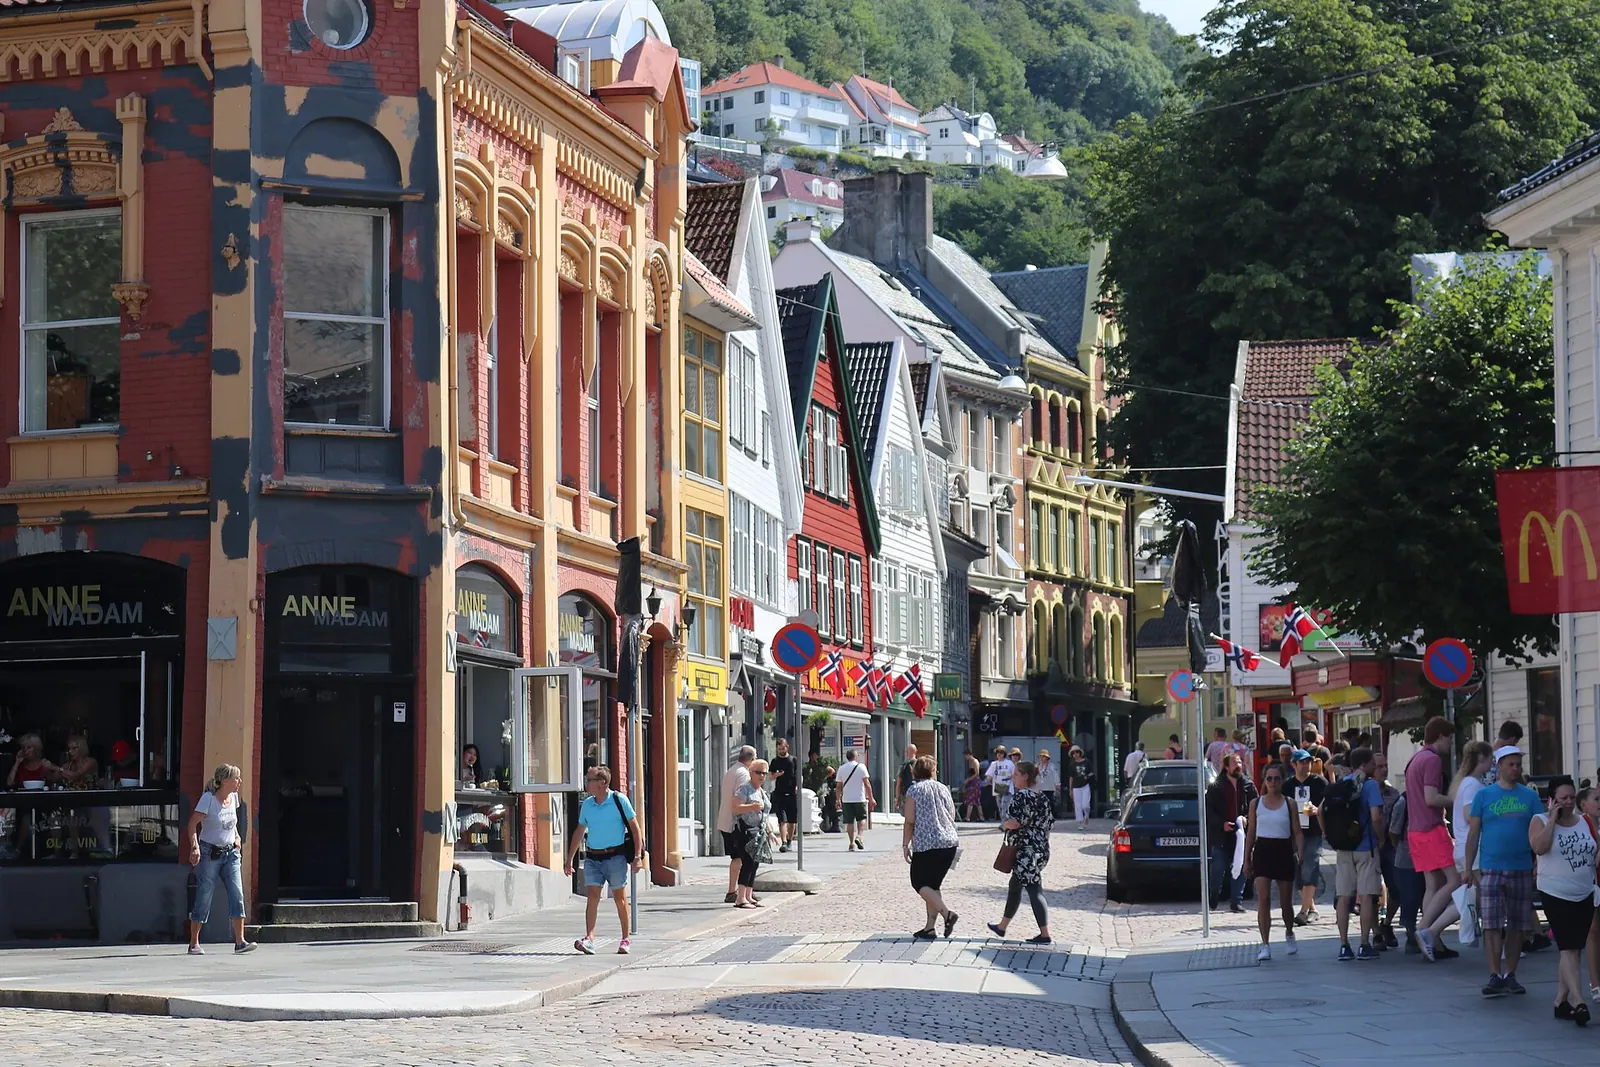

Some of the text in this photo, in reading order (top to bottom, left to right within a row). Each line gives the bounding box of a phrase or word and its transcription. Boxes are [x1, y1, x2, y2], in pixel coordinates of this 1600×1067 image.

[7, 584, 101, 616] ANNE
[282, 594, 356, 618] ANNE
[457, 588, 487, 617] ANNE
[47, 601, 143, 626] MADAM
[313, 608, 388, 628] MADAM
[469, 609, 500, 635] MADAM
[560, 612, 584, 637] ANNE
[569, 631, 595, 653] MADAM
[940, 687, 960, 699] Vinyl
[46, 838, 62, 849] ØL
[77, 837, 97, 849] VIN
